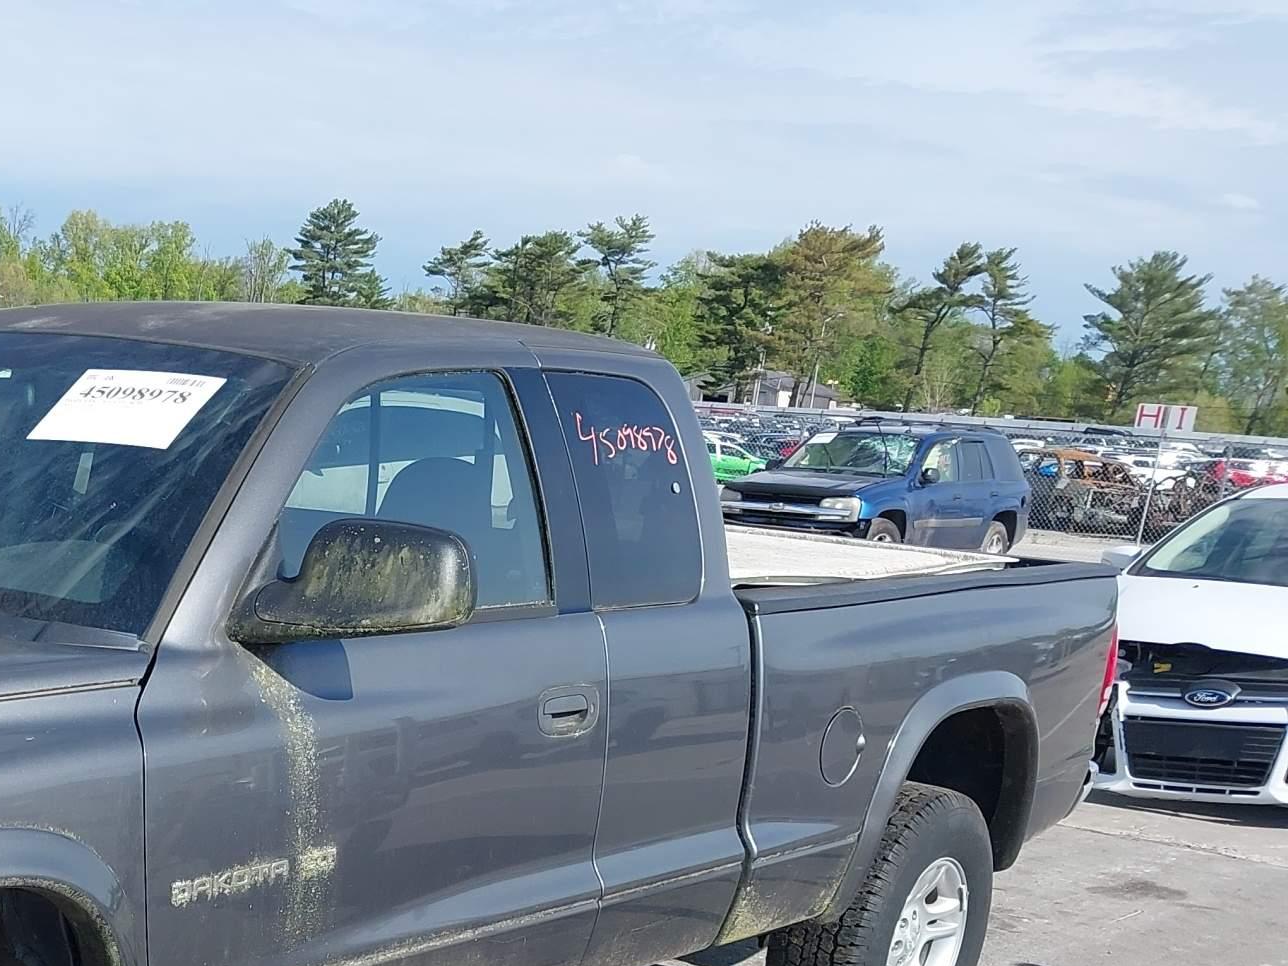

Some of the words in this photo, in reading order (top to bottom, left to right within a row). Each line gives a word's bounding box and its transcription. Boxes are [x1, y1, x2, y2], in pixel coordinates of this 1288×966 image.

[80, 384, 192, 404] 45098978
[575, 412, 678, 465] 45098978
[1193, 691, 1219, 703] Ford
[170, 858, 290, 908] DAKOTA
